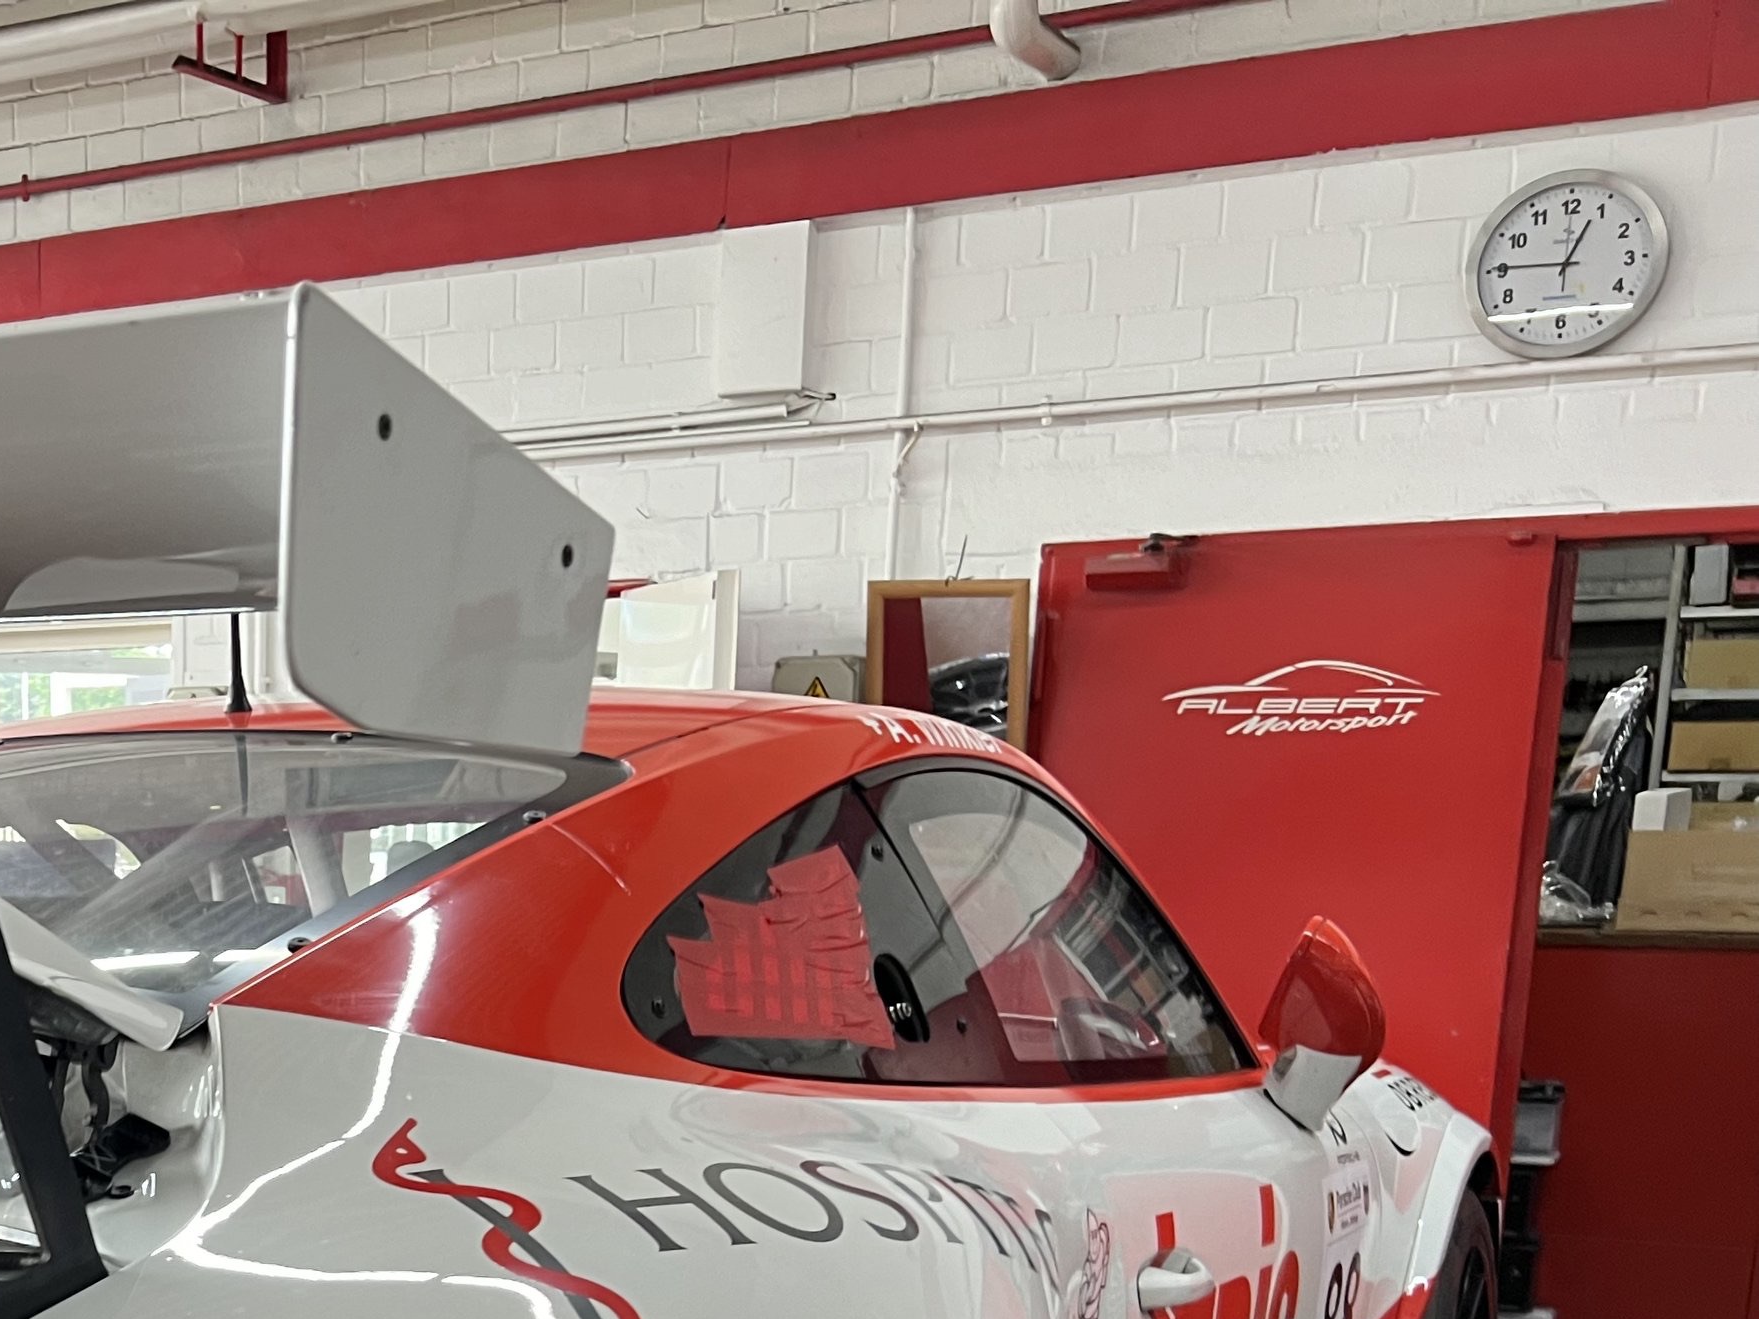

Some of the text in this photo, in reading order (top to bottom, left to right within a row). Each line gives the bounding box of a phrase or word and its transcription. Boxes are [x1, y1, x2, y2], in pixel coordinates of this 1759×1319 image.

[1561, 198, 1581, 215] 12
[1596, 203, 1605, 218] 1
[1531, 209, 1548, 226] 11
[1618, 223, 1629, 239] 2
[1508, 233, 1527, 249] 10
[1623, 250, 1635, 266] 3
[1497, 263, 1509, 278] 9
[1612, 278, 1624, 293] 4
[1503, 289, 1513, 304] 8
[1555, 314, 1566, 329] 6
[1177, 698, 1424, 714] ALBERT
[1226, 710, 1418, 736] Motorsport
